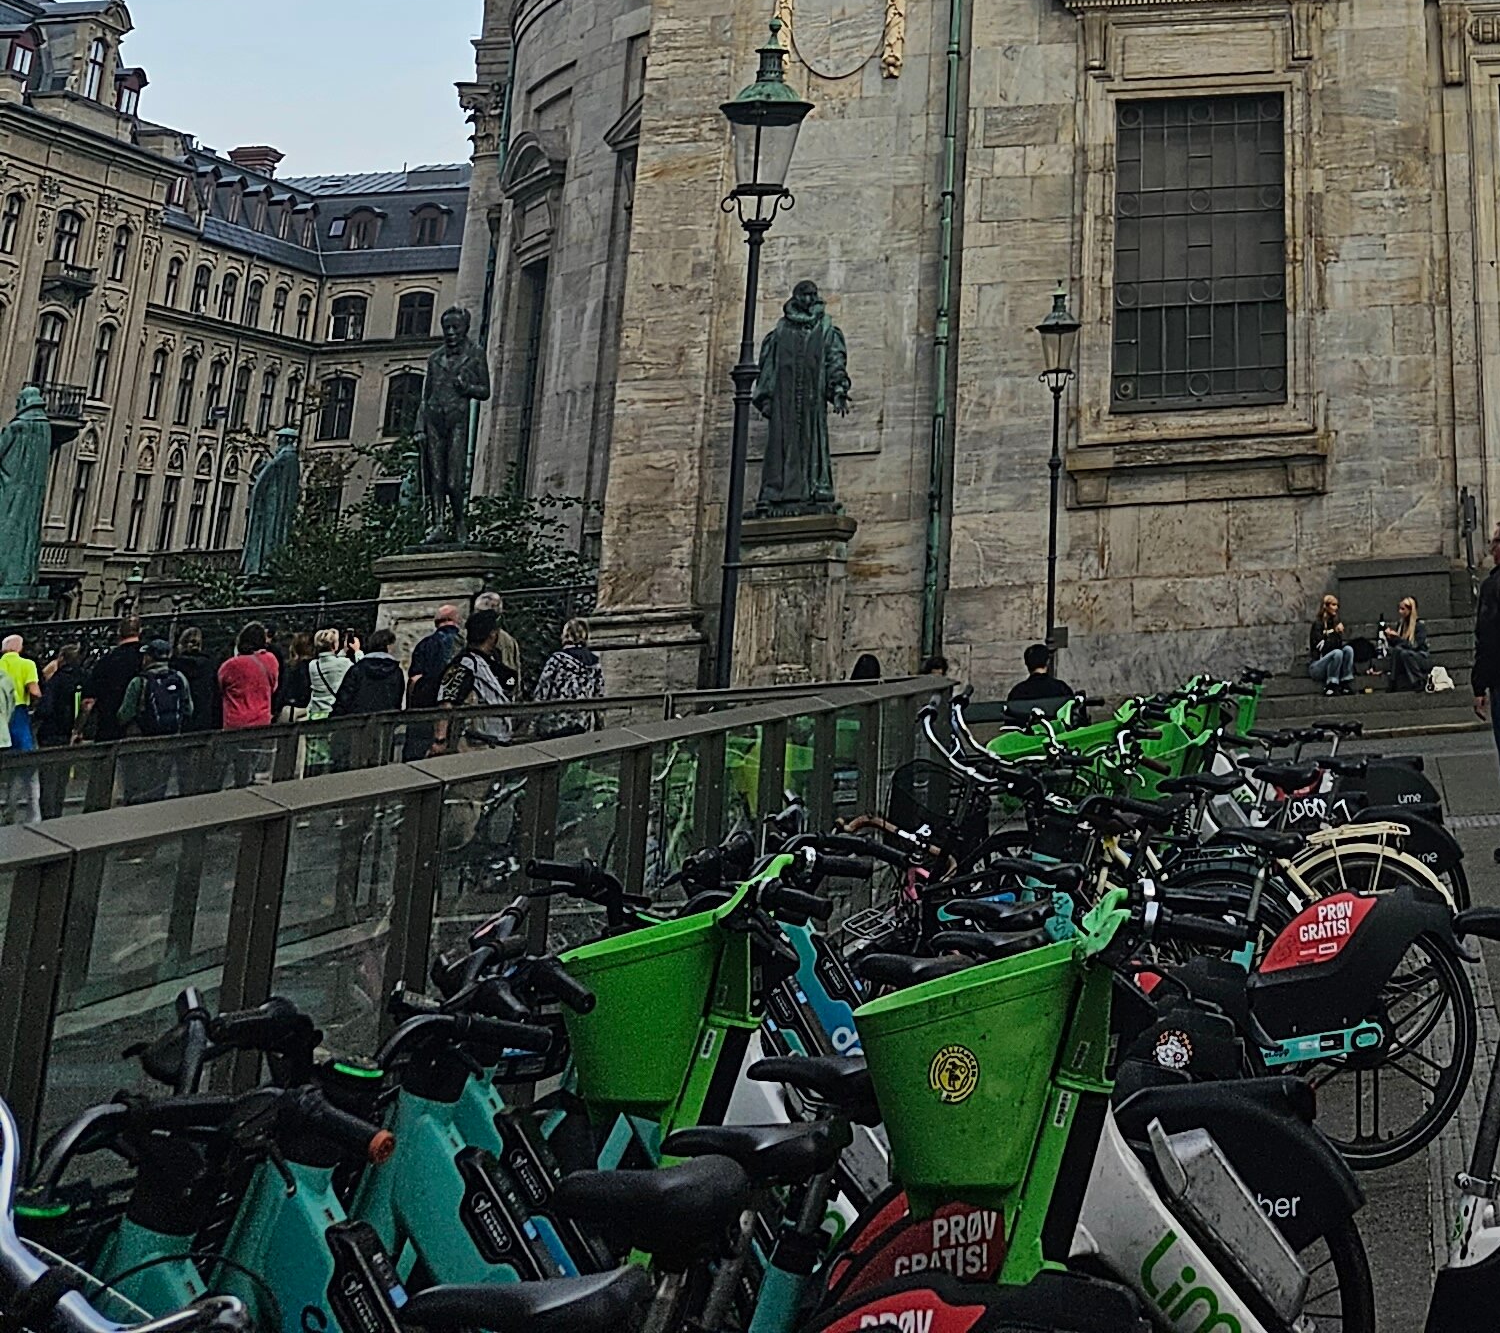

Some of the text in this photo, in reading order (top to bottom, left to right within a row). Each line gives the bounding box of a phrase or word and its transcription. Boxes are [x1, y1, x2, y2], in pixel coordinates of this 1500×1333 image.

[1317, 901, 1354, 922] PRØV
[1299, 918, 1351, 942] GRATIS!
[1257, 1193, 1301, 1218] ber
[932, 1210, 997, 1249] PRØV
[1141, 1229, 1242, 1333] Lim
